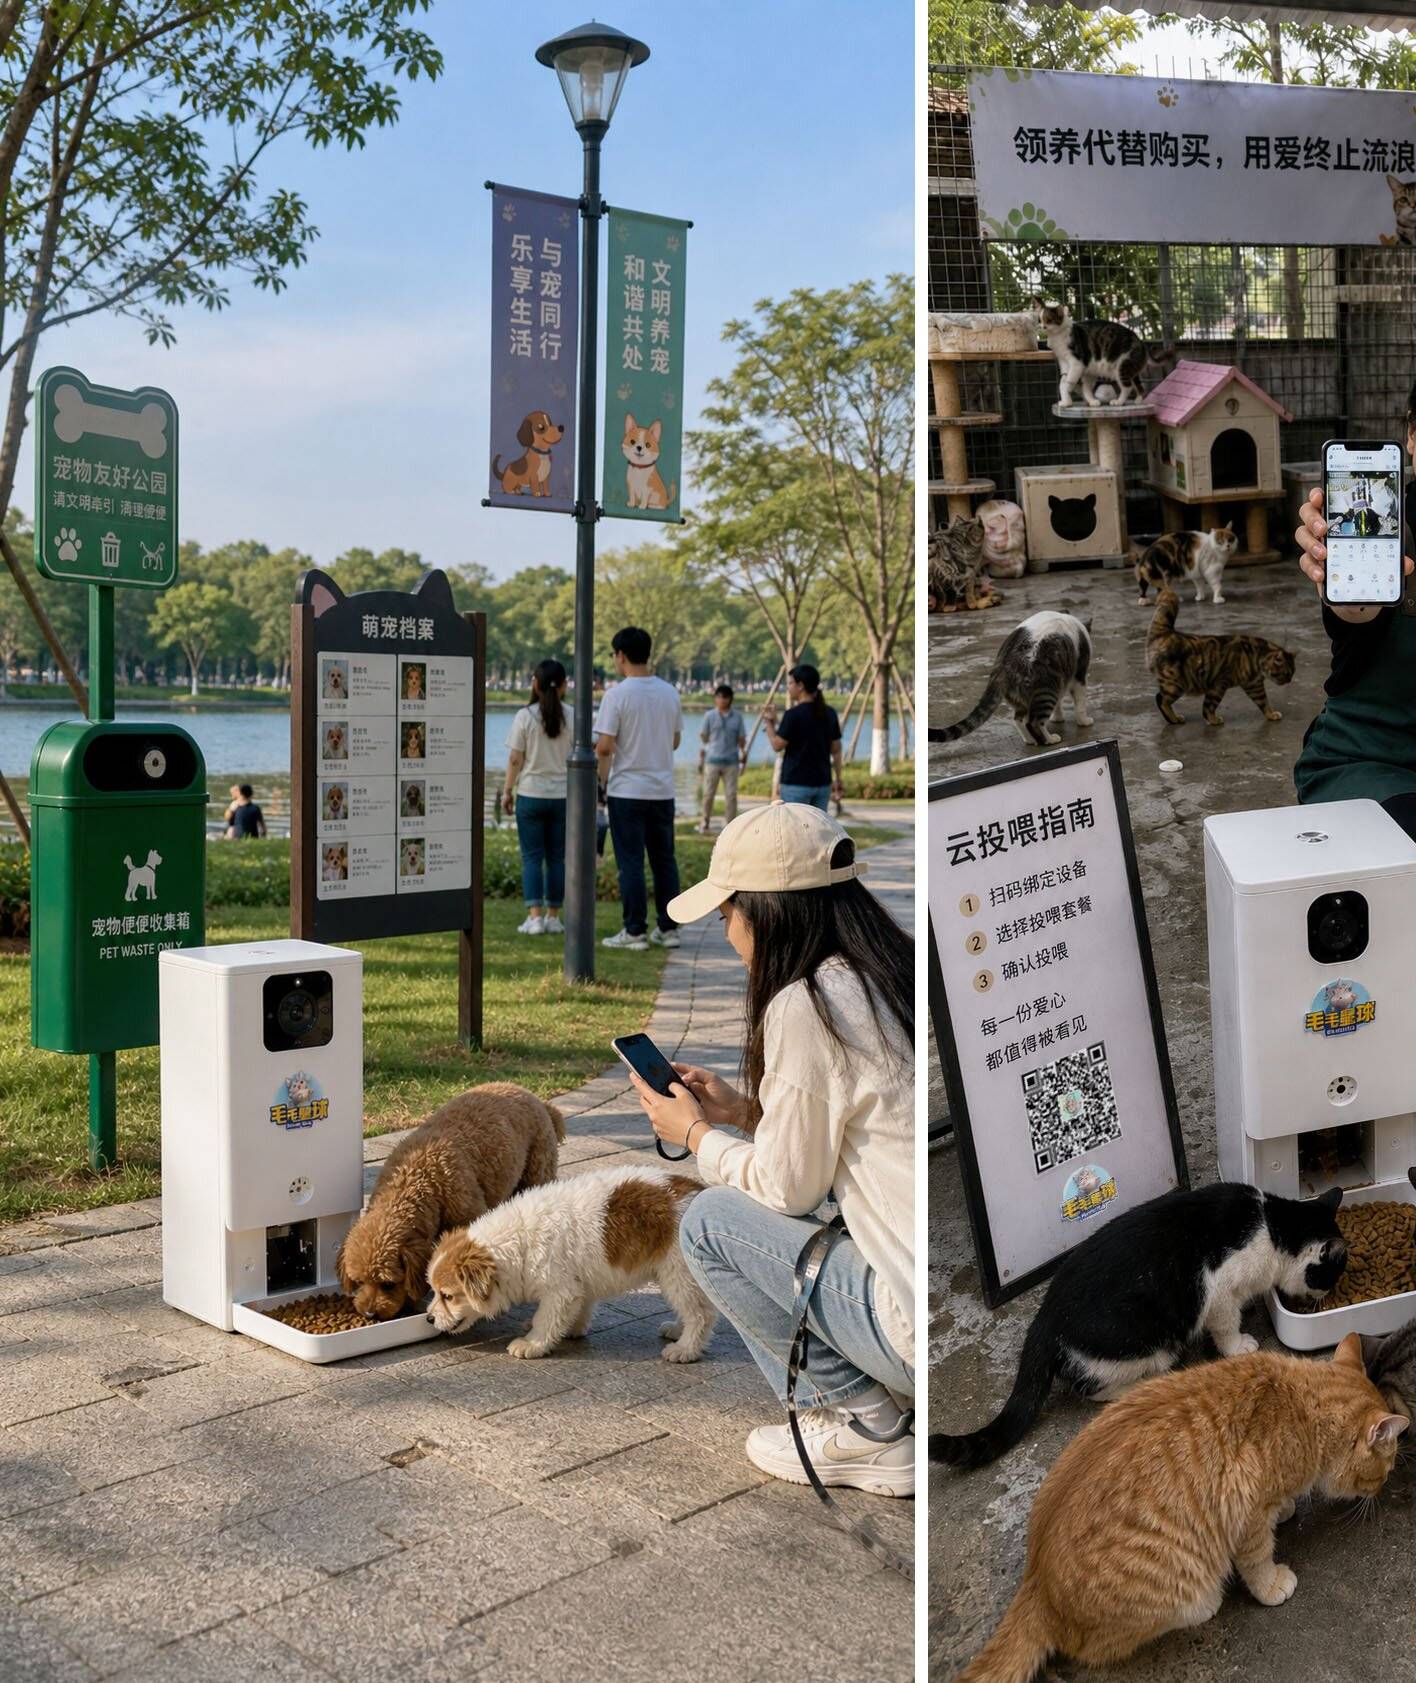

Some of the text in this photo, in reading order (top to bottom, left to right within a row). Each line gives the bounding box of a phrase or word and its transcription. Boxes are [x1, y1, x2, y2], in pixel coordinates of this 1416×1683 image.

[1013, 126, 1416, 173] 领养代替购买，用爱终止流浪
[509, 234, 533, 358] 乐享生活
[540, 238, 562, 361] 与宠同行
[622, 254, 645, 371] 和谐共处
[650, 259, 671, 374] 文明养宠
[53, 455, 167, 495] 宠物友好公园
[362, 614, 435, 641] 萌宠档案
[945, 797, 1096, 867] 云投喂指南
[989, 860, 1088, 907] 扫码绑定设备
[92, 912, 190, 937] 宠物便便收集箱
[996, 895, 1093, 945] 选择投喂套餐
[100, 941, 183, 960] PET WASTE ONLY
[1001, 941, 1070, 982] 确认投喂
[980, 991, 1067, 1037] 每一份爱心
[985, 1014, 1089, 1072] 都值得被看见
